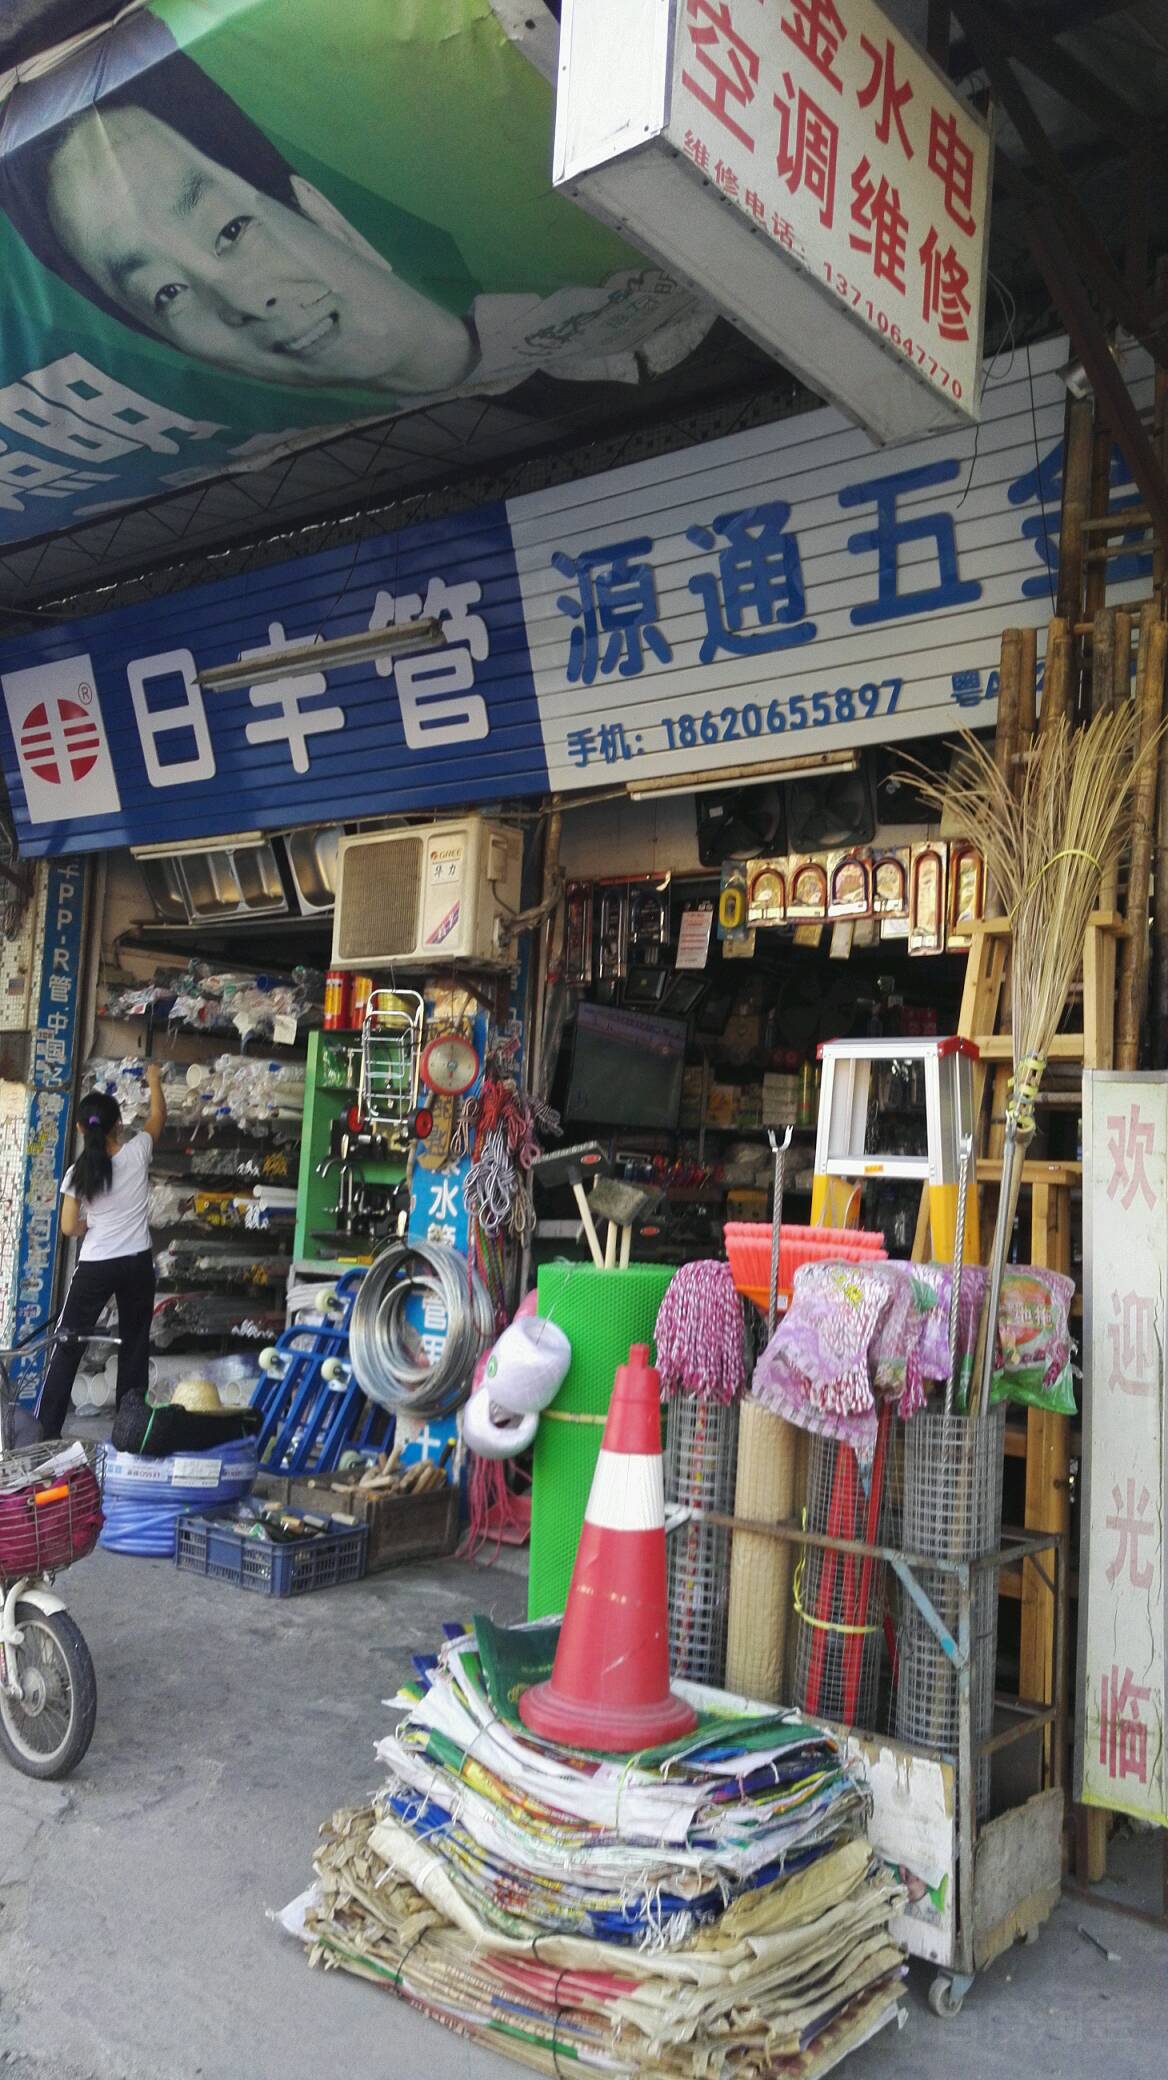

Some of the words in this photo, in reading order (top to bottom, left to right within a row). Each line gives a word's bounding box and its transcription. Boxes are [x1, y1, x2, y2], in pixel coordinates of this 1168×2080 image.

[682, 0, 972, 342] 空调维修
[757, 0, 977, 237] 金水电
[823, 261, 963, 400] 13710647770
[127, 577, 489, 787] 日丰管
[661, 679, 904, 752] 18620655897
[1099, 1103, 1158, 1784] 欢迎光临
